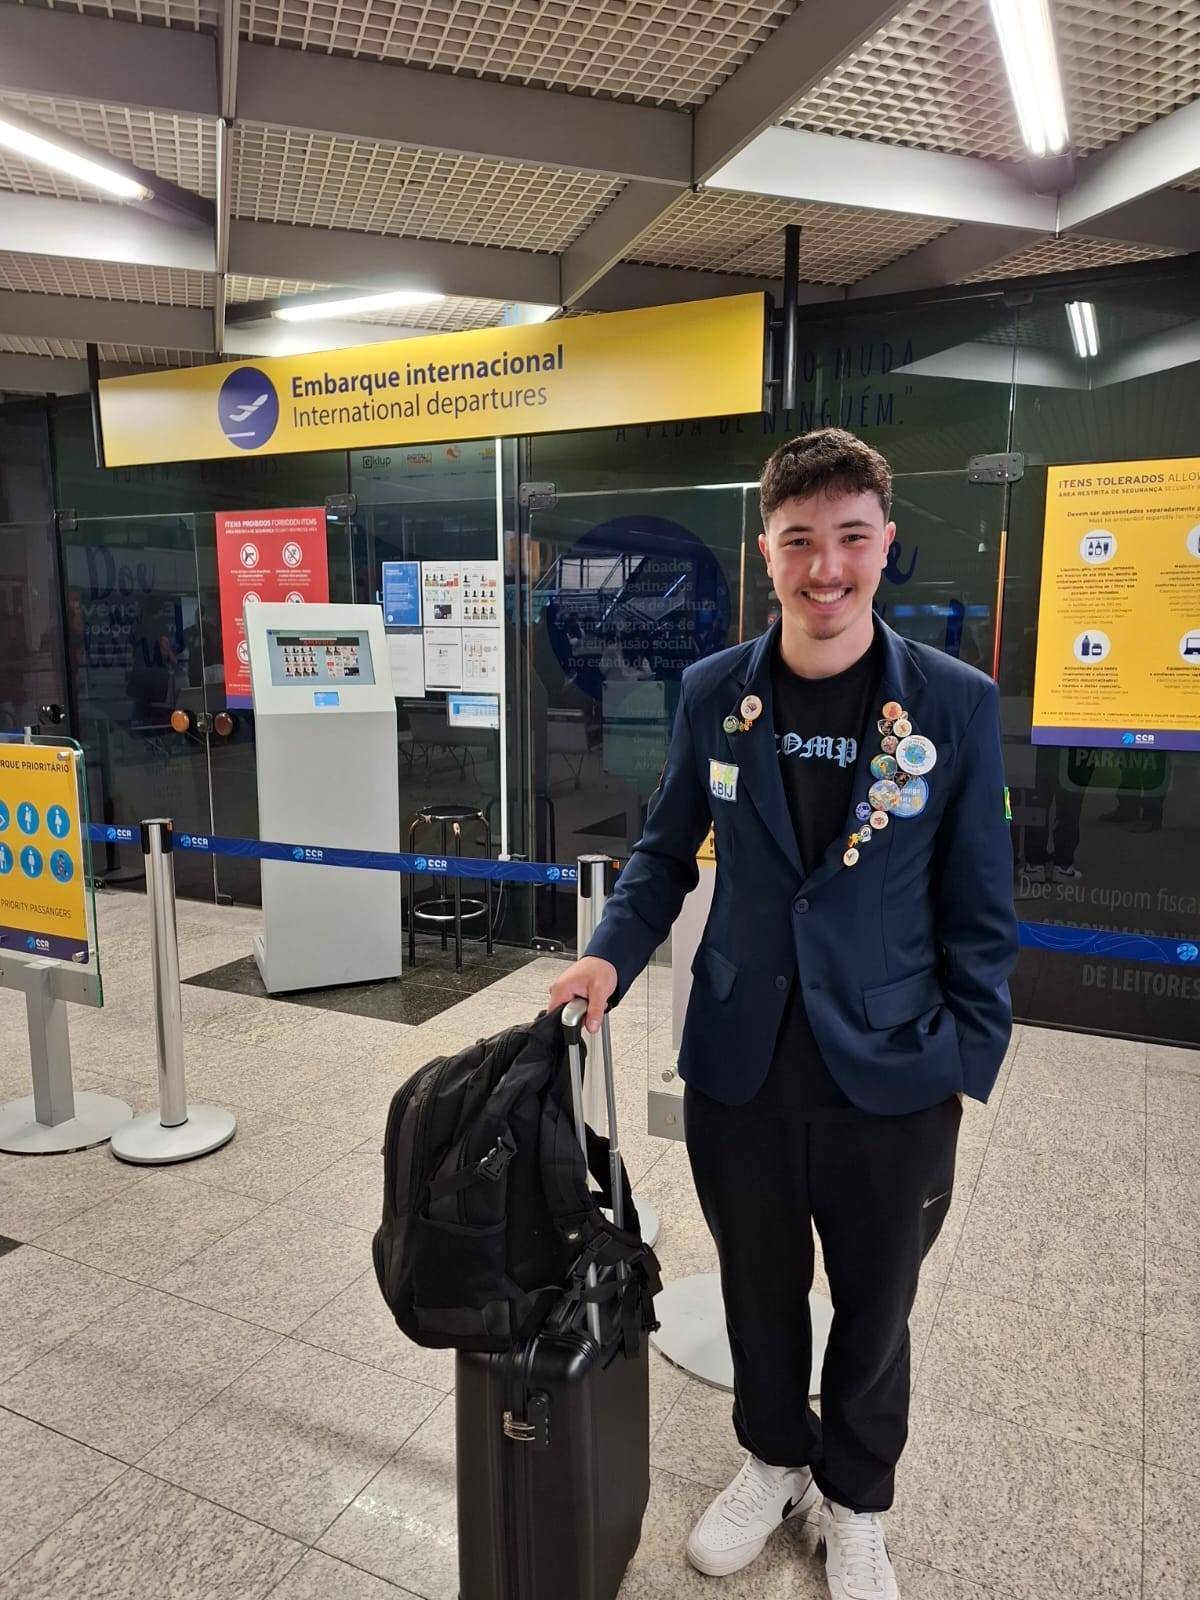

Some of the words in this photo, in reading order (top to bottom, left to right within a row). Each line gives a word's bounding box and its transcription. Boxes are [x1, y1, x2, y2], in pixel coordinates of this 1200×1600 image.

[292, 372, 400, 398] Embarque
[406, 344, 563, 386] internacional
[293, 393, 420, 428] International
[427, 387, 548, 419] departures
[1058, 478, 1093, 489] ITENS
[1096, 473, 1165, 487] TOLERADOS
[1121, 486, 1163, 495] SEGURANÇA
[1135, 734, 1155, 742] CCR
[774, 731, 858, 769] OMP
[21, 761, 70, 773] PRIORITÁRIO
[116, 829, 132, 838] CCR
[191, 836, 209, 846] CCR
[305, 848, 323, 858] CCR
[428, 858, 448, 868] CCR
[561, 868, 578, 878] CC
[1019, 875, 1052, 899] Doe
[1055, 882, 1086, 904] seu
[1090, 886, 1151, 913] cupom
[1, 898, 29, 911] PRIORITY
[35, 938, 50, 949] CCR
[1082, 964, 1107, 989] DE
